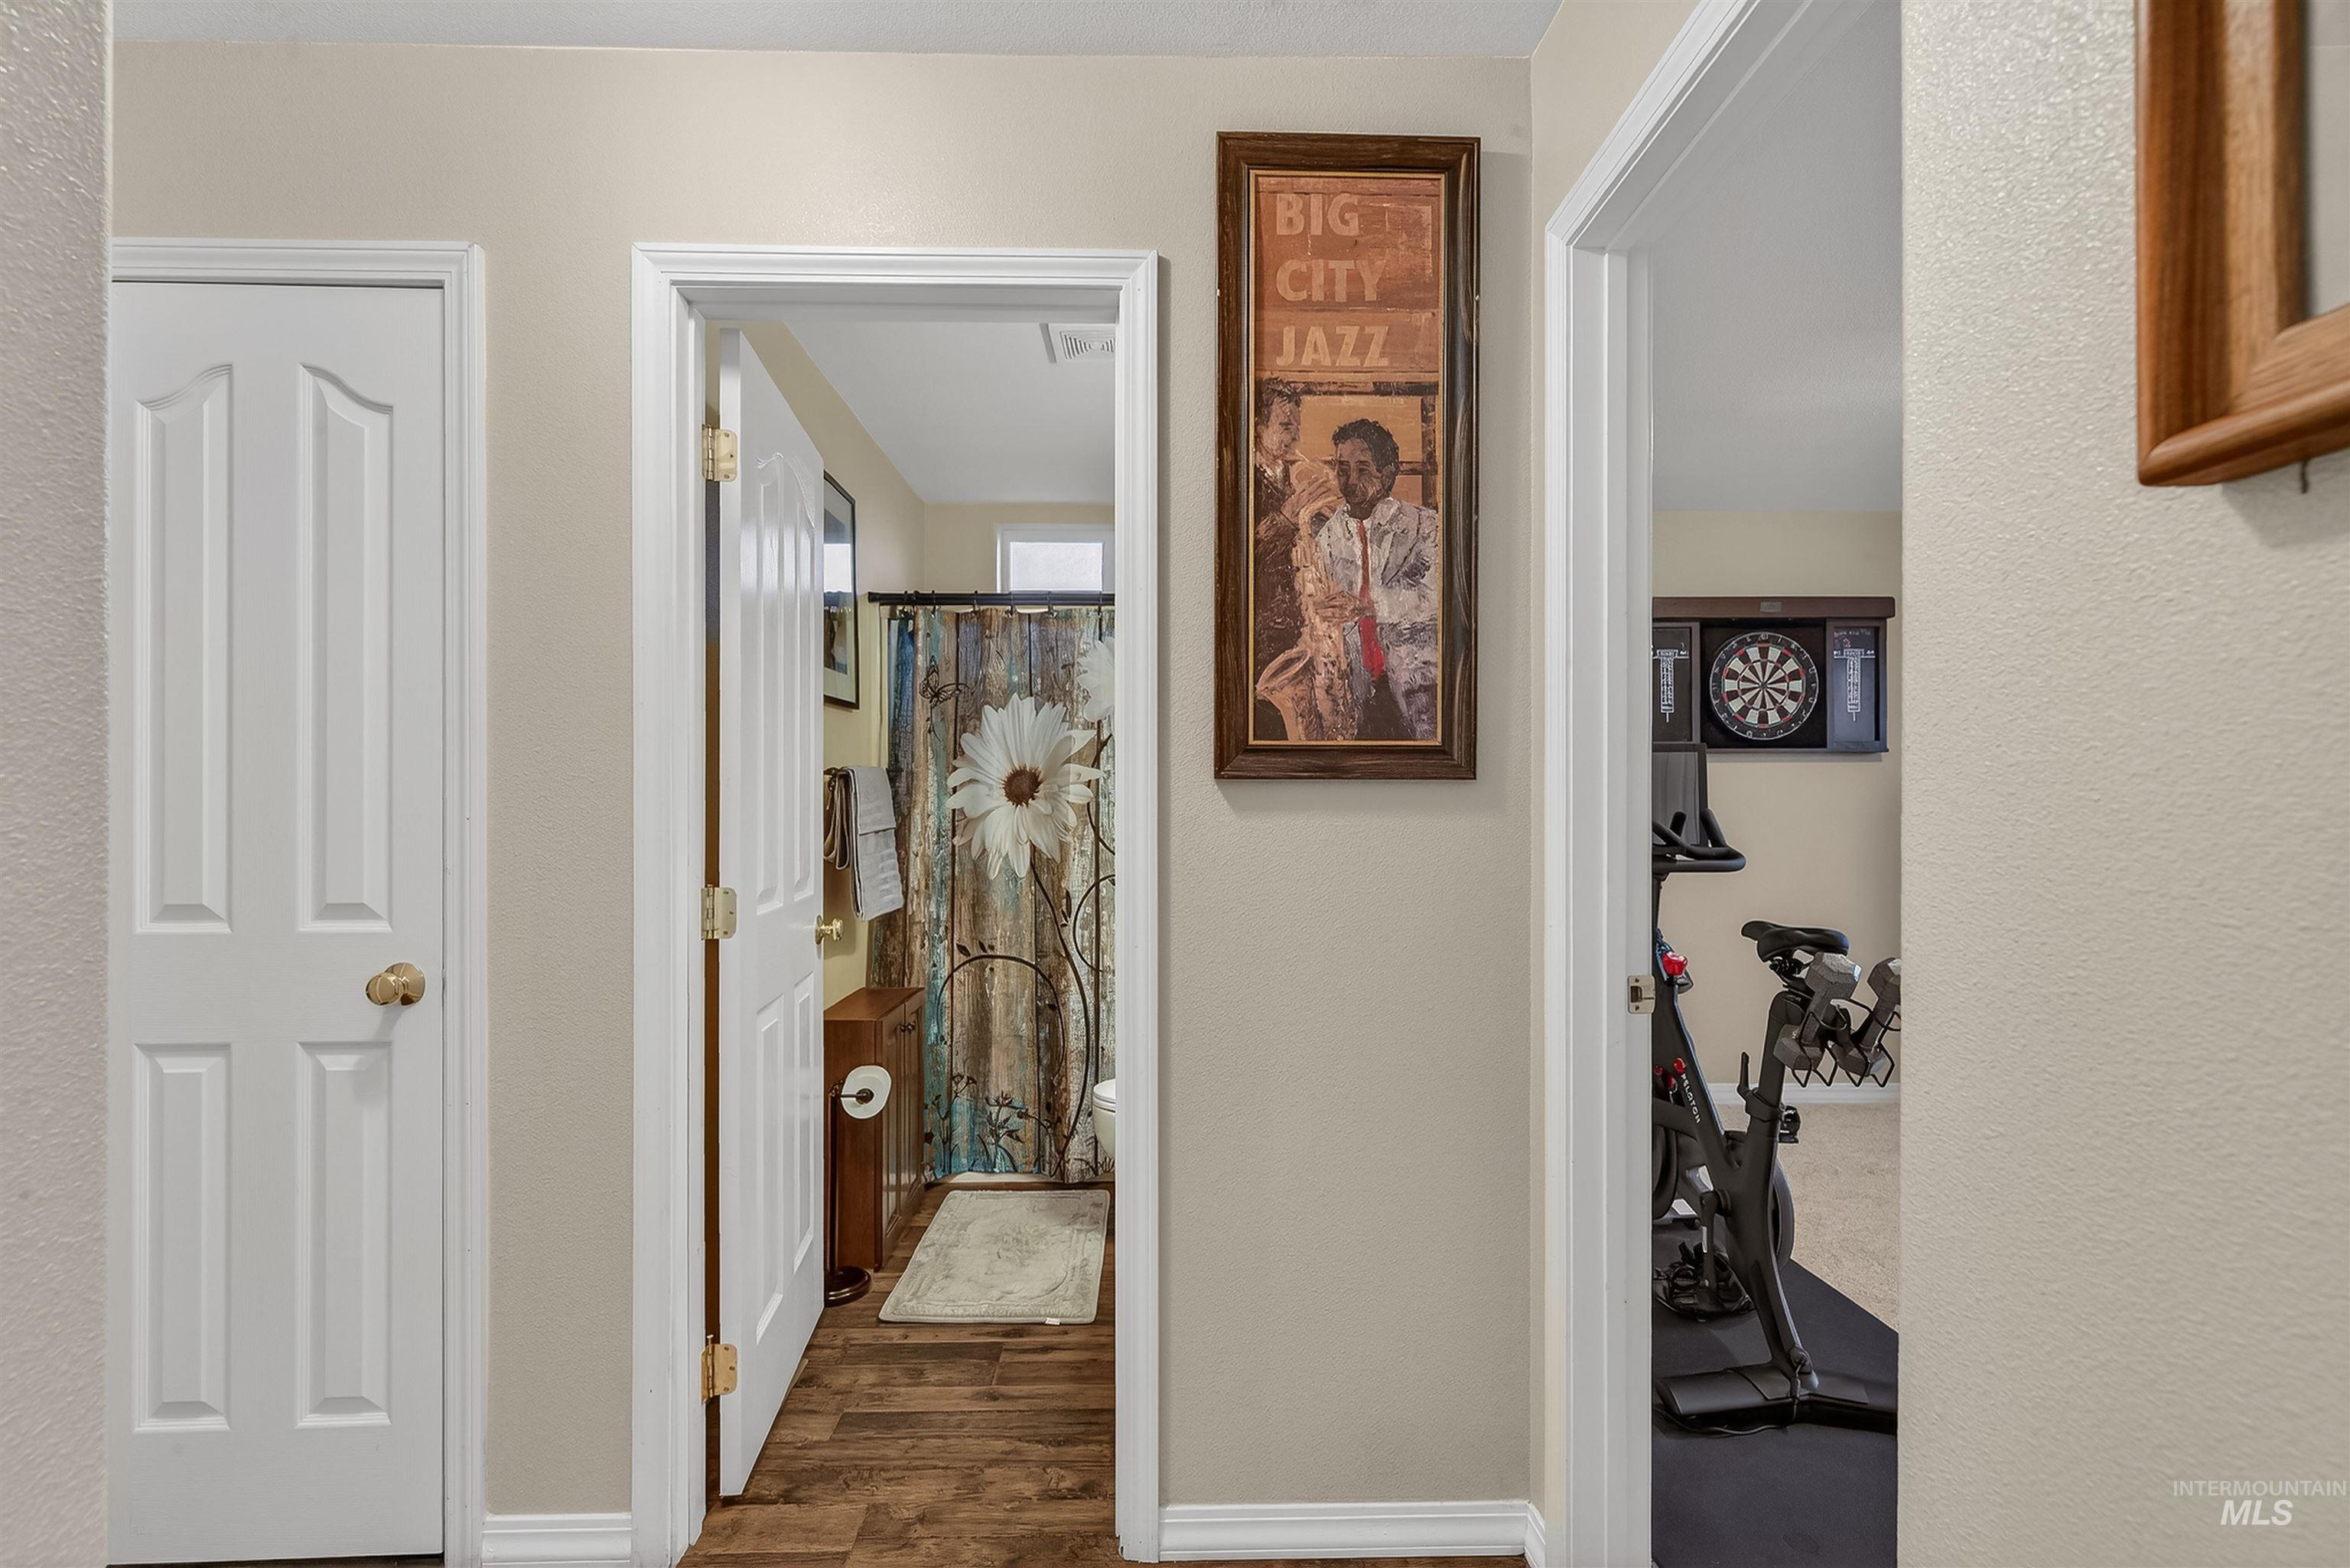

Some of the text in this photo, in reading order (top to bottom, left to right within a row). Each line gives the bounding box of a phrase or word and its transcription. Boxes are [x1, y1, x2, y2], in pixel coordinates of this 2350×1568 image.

[1276, 194, 1359, 236] BIG
[1276, 260, 1386, 302] CITY
[1275, 326, 1389, 367] JAZZ
[1681, 1073, 1701, 1124] PELOTON
